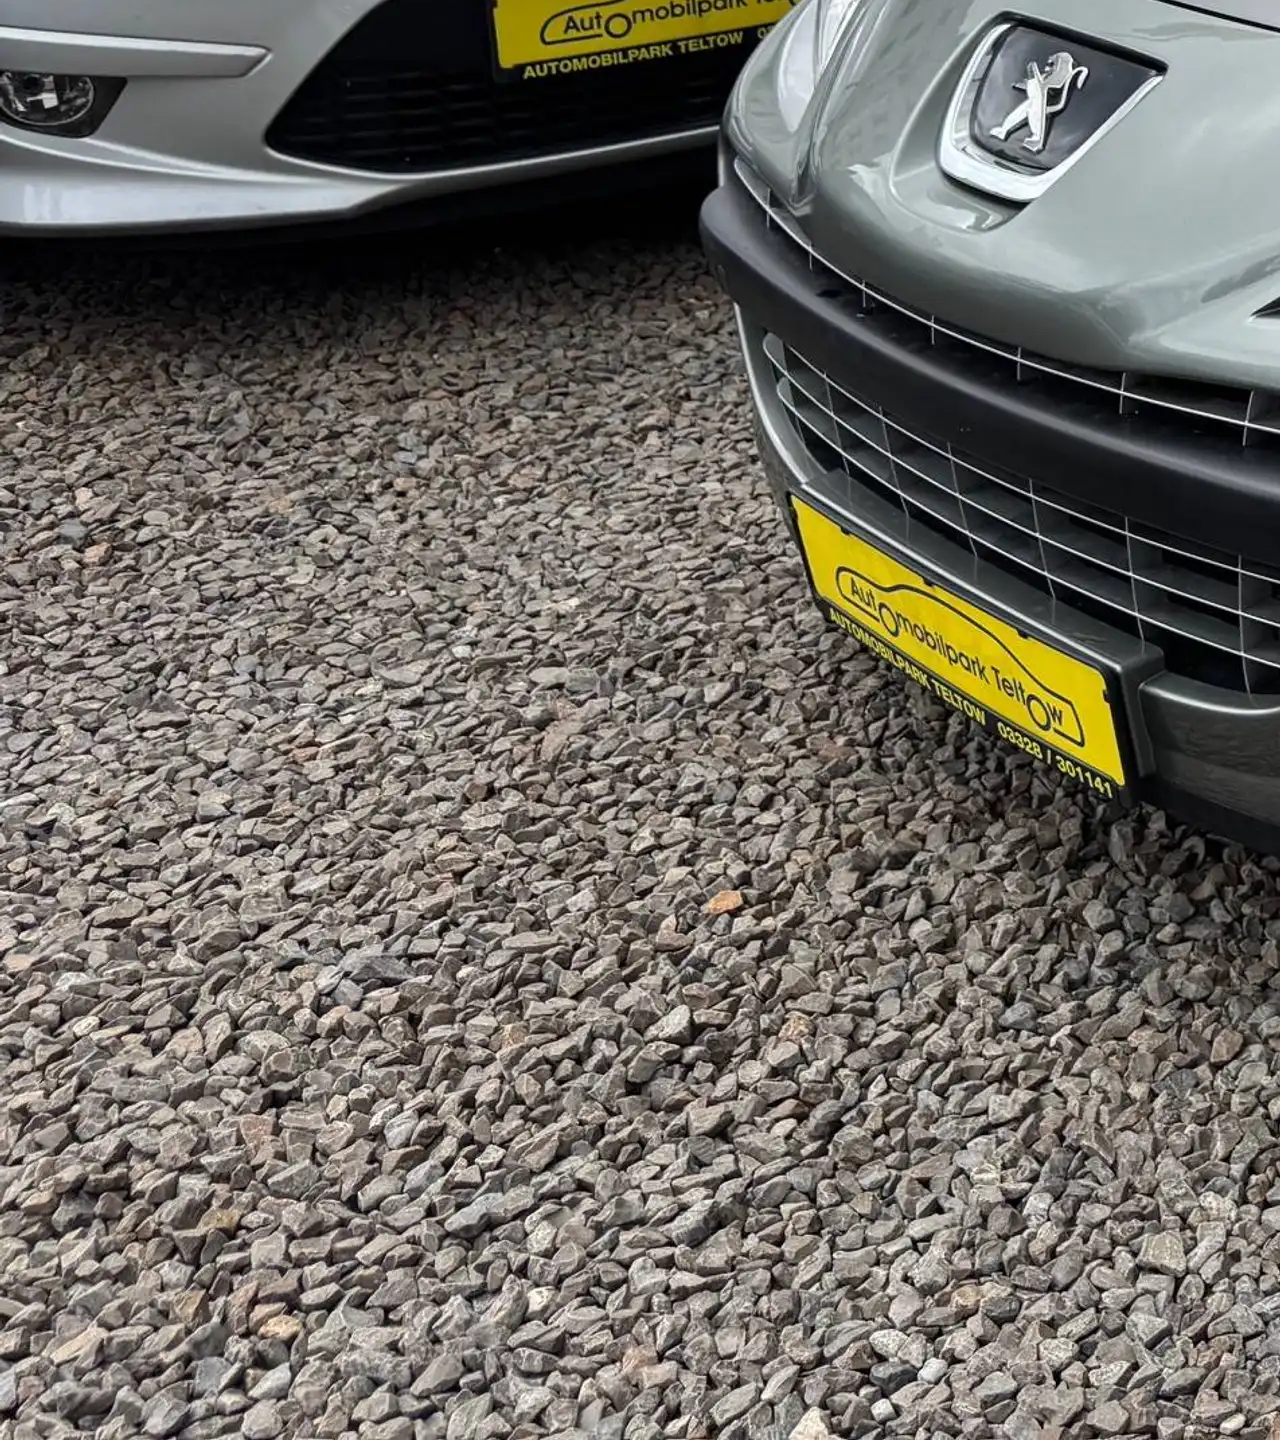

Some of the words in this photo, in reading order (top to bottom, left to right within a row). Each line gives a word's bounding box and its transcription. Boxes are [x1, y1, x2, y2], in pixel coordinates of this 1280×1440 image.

[523, 42, 673, 80] AUTOMOBILPARK
[677, 30, 743, 55] TELTOW
[829, 608, 931, 693] AUTOMOBILPARK
[934, 679, 986, 726] TELTOW
[998, 722, 1043, 759] 03328
[1056, 754, 1113, 799] 301141
